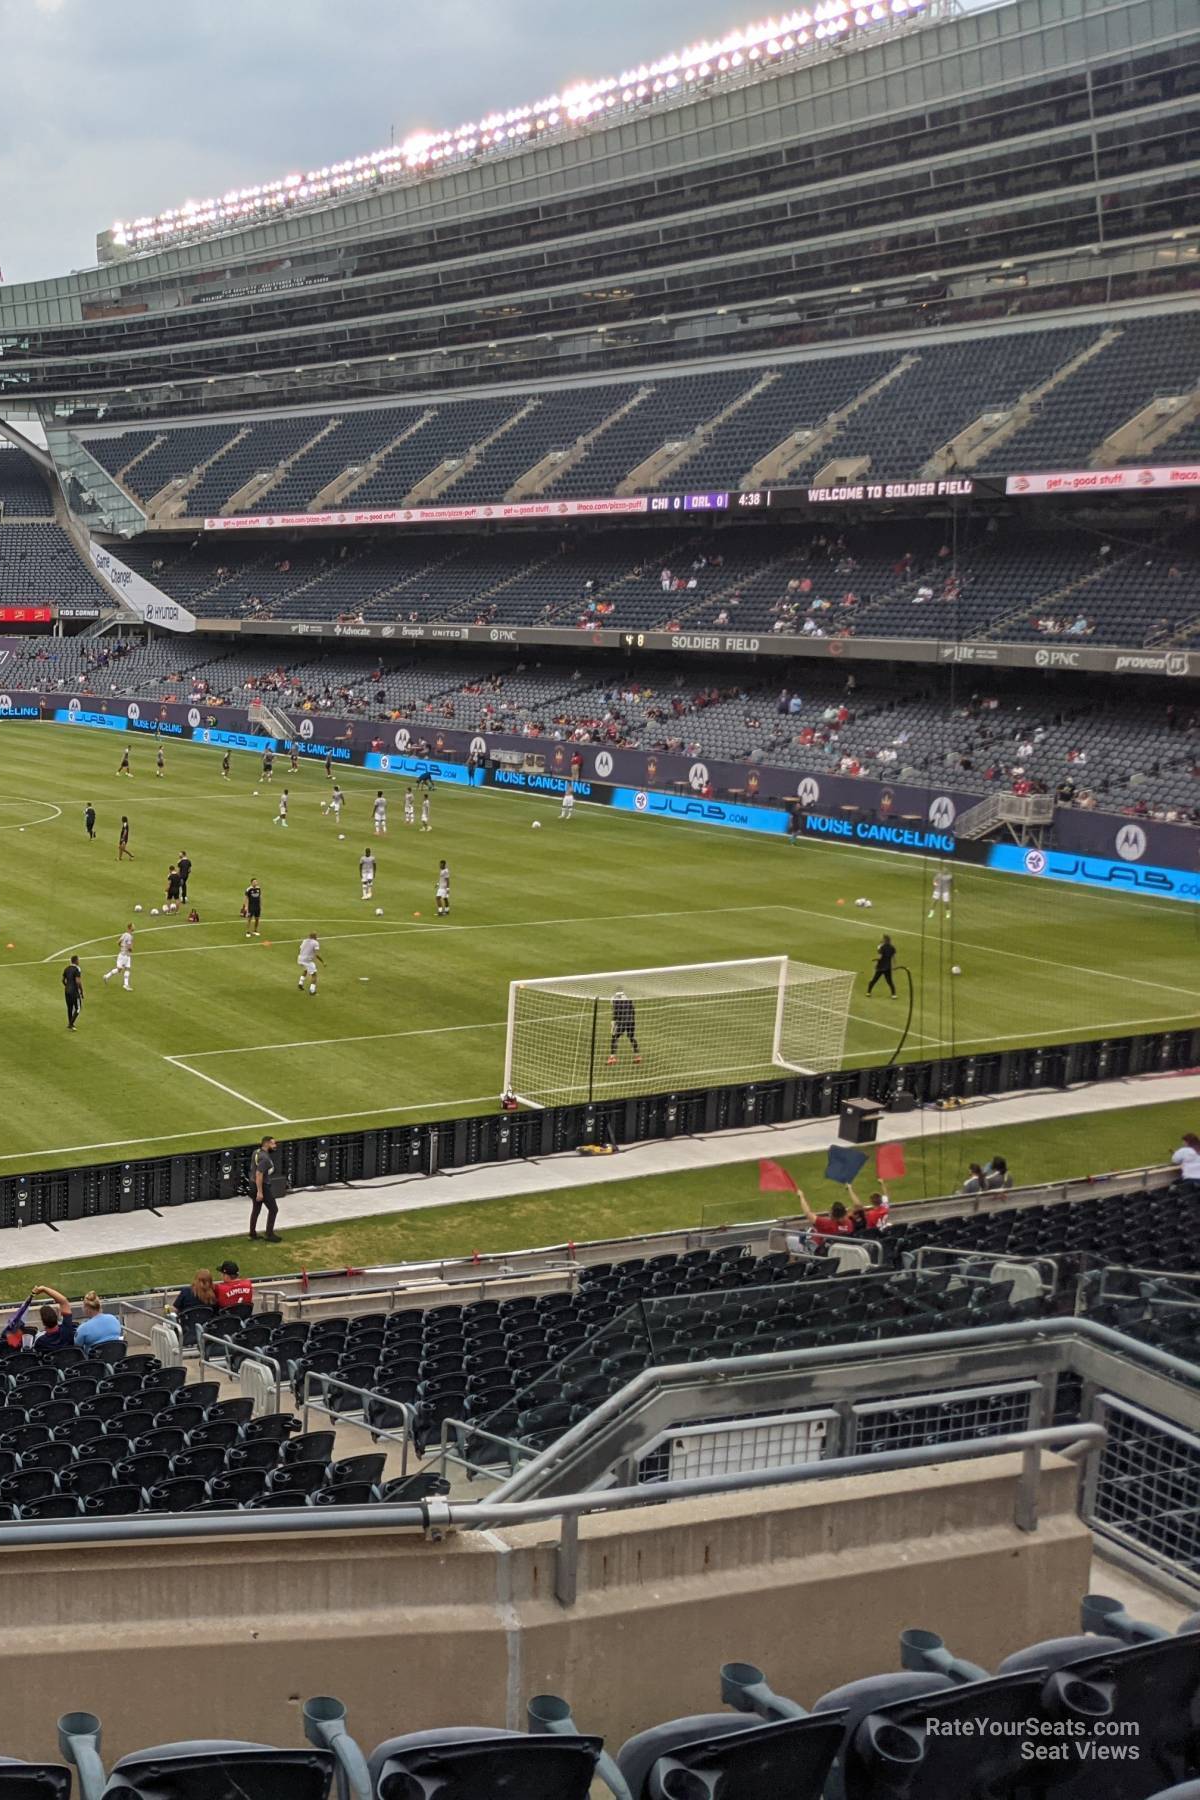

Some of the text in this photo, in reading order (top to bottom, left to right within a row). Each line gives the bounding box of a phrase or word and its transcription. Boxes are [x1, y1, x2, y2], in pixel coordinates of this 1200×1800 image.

[1046, 479, 1062, 489] get
[1073, 477, 1097, 487] good
[1099, 473, 1122, 484] stuff
[808, 480, 973, 502] WELCOME TO SOLDIER FIELD
[652, 494, 760, 509] CHI 0 ORL 0 4:38
[154, 605, 179, 620] HYUNDAI
[342, 627, 370, 636] Advocate
[500, 630, 517, 640] PNC
[672, 636, 759, 651] SOLDIER FIELD
[1051, 653, 1079, 666] PNC
[495, 770, 525, 786] NOISE
[806, 815, 955, 851] NOISE CANCELING
